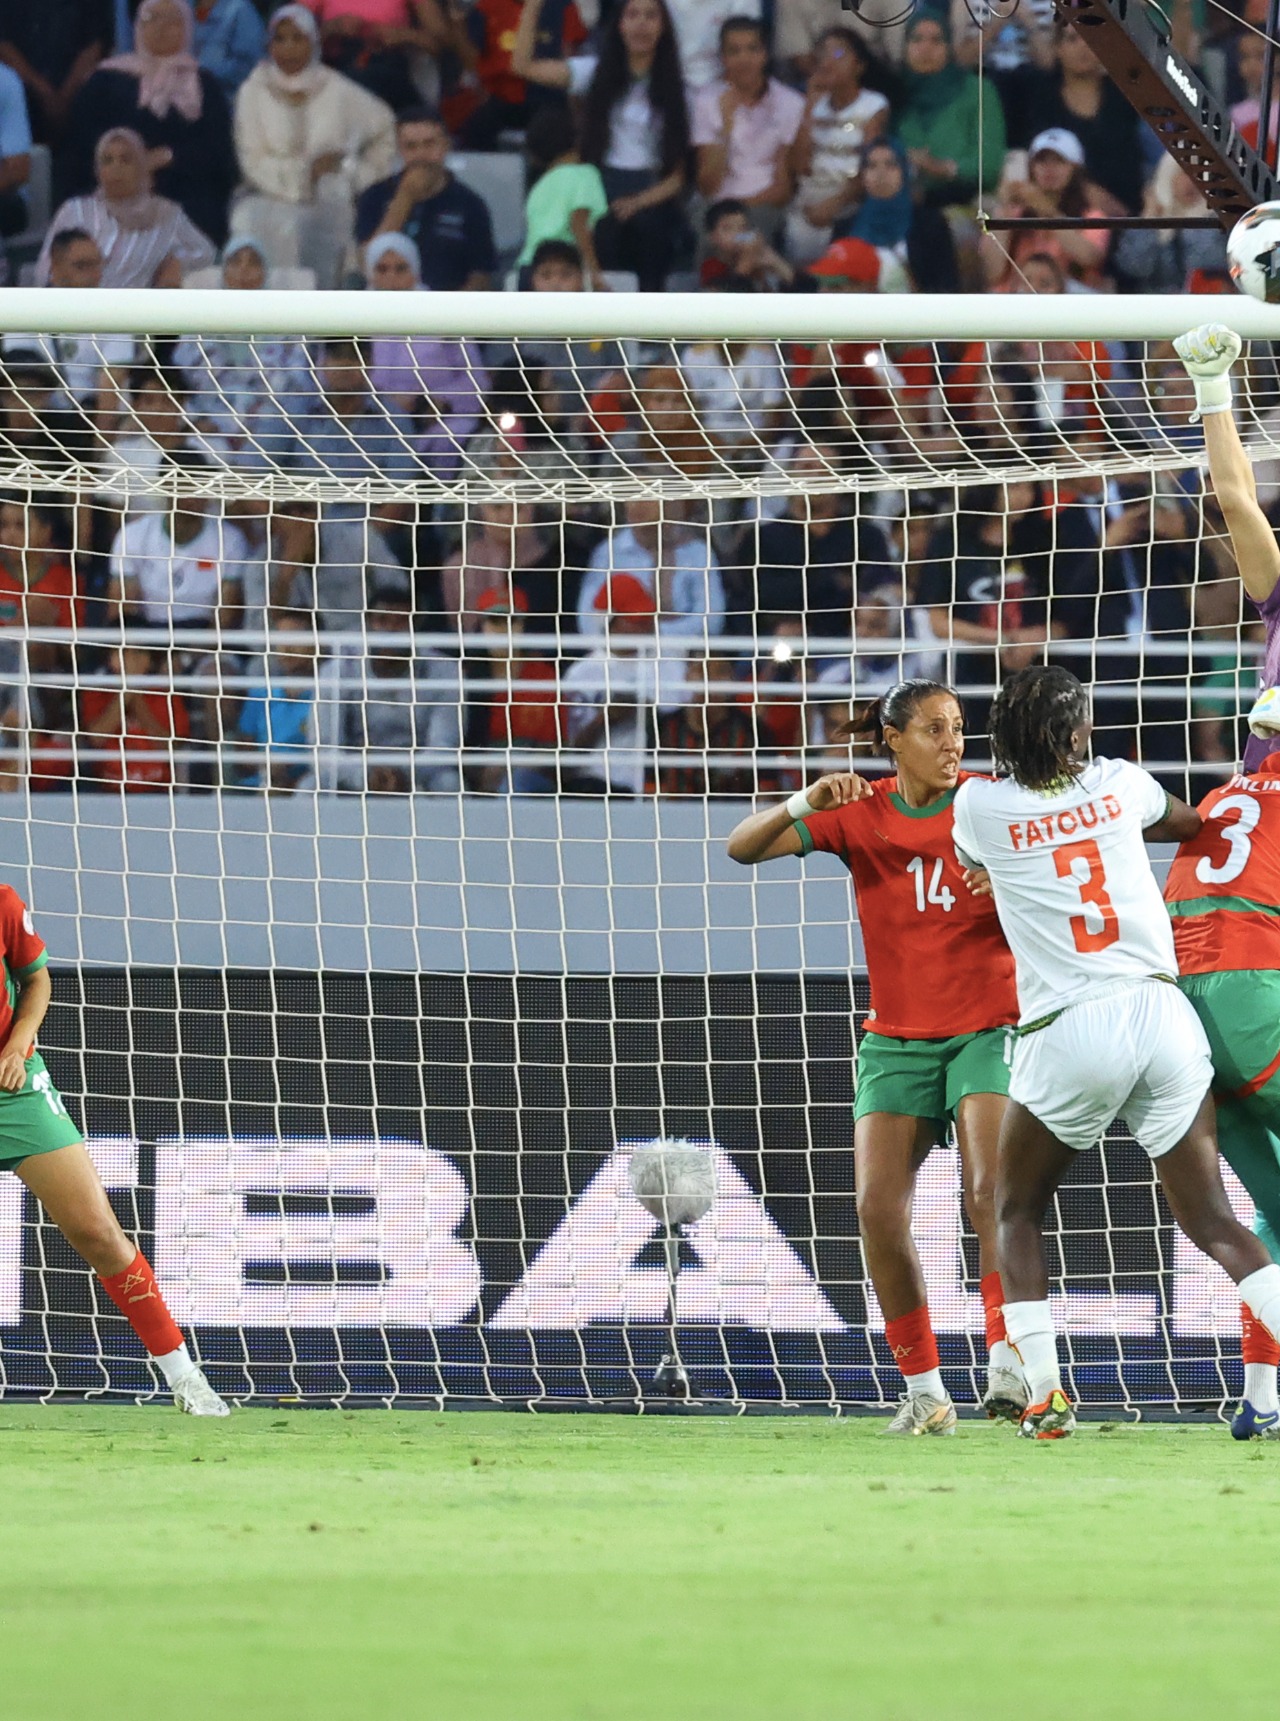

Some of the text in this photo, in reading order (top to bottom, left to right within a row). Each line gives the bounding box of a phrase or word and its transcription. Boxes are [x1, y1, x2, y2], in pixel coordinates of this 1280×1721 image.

[1008, 795, 1123, 850] FATOU.D
[1195, 794, 1261, 884] 3
[906, 856, 956, 912] 14
[1052, 839, 1120, 953] 3
